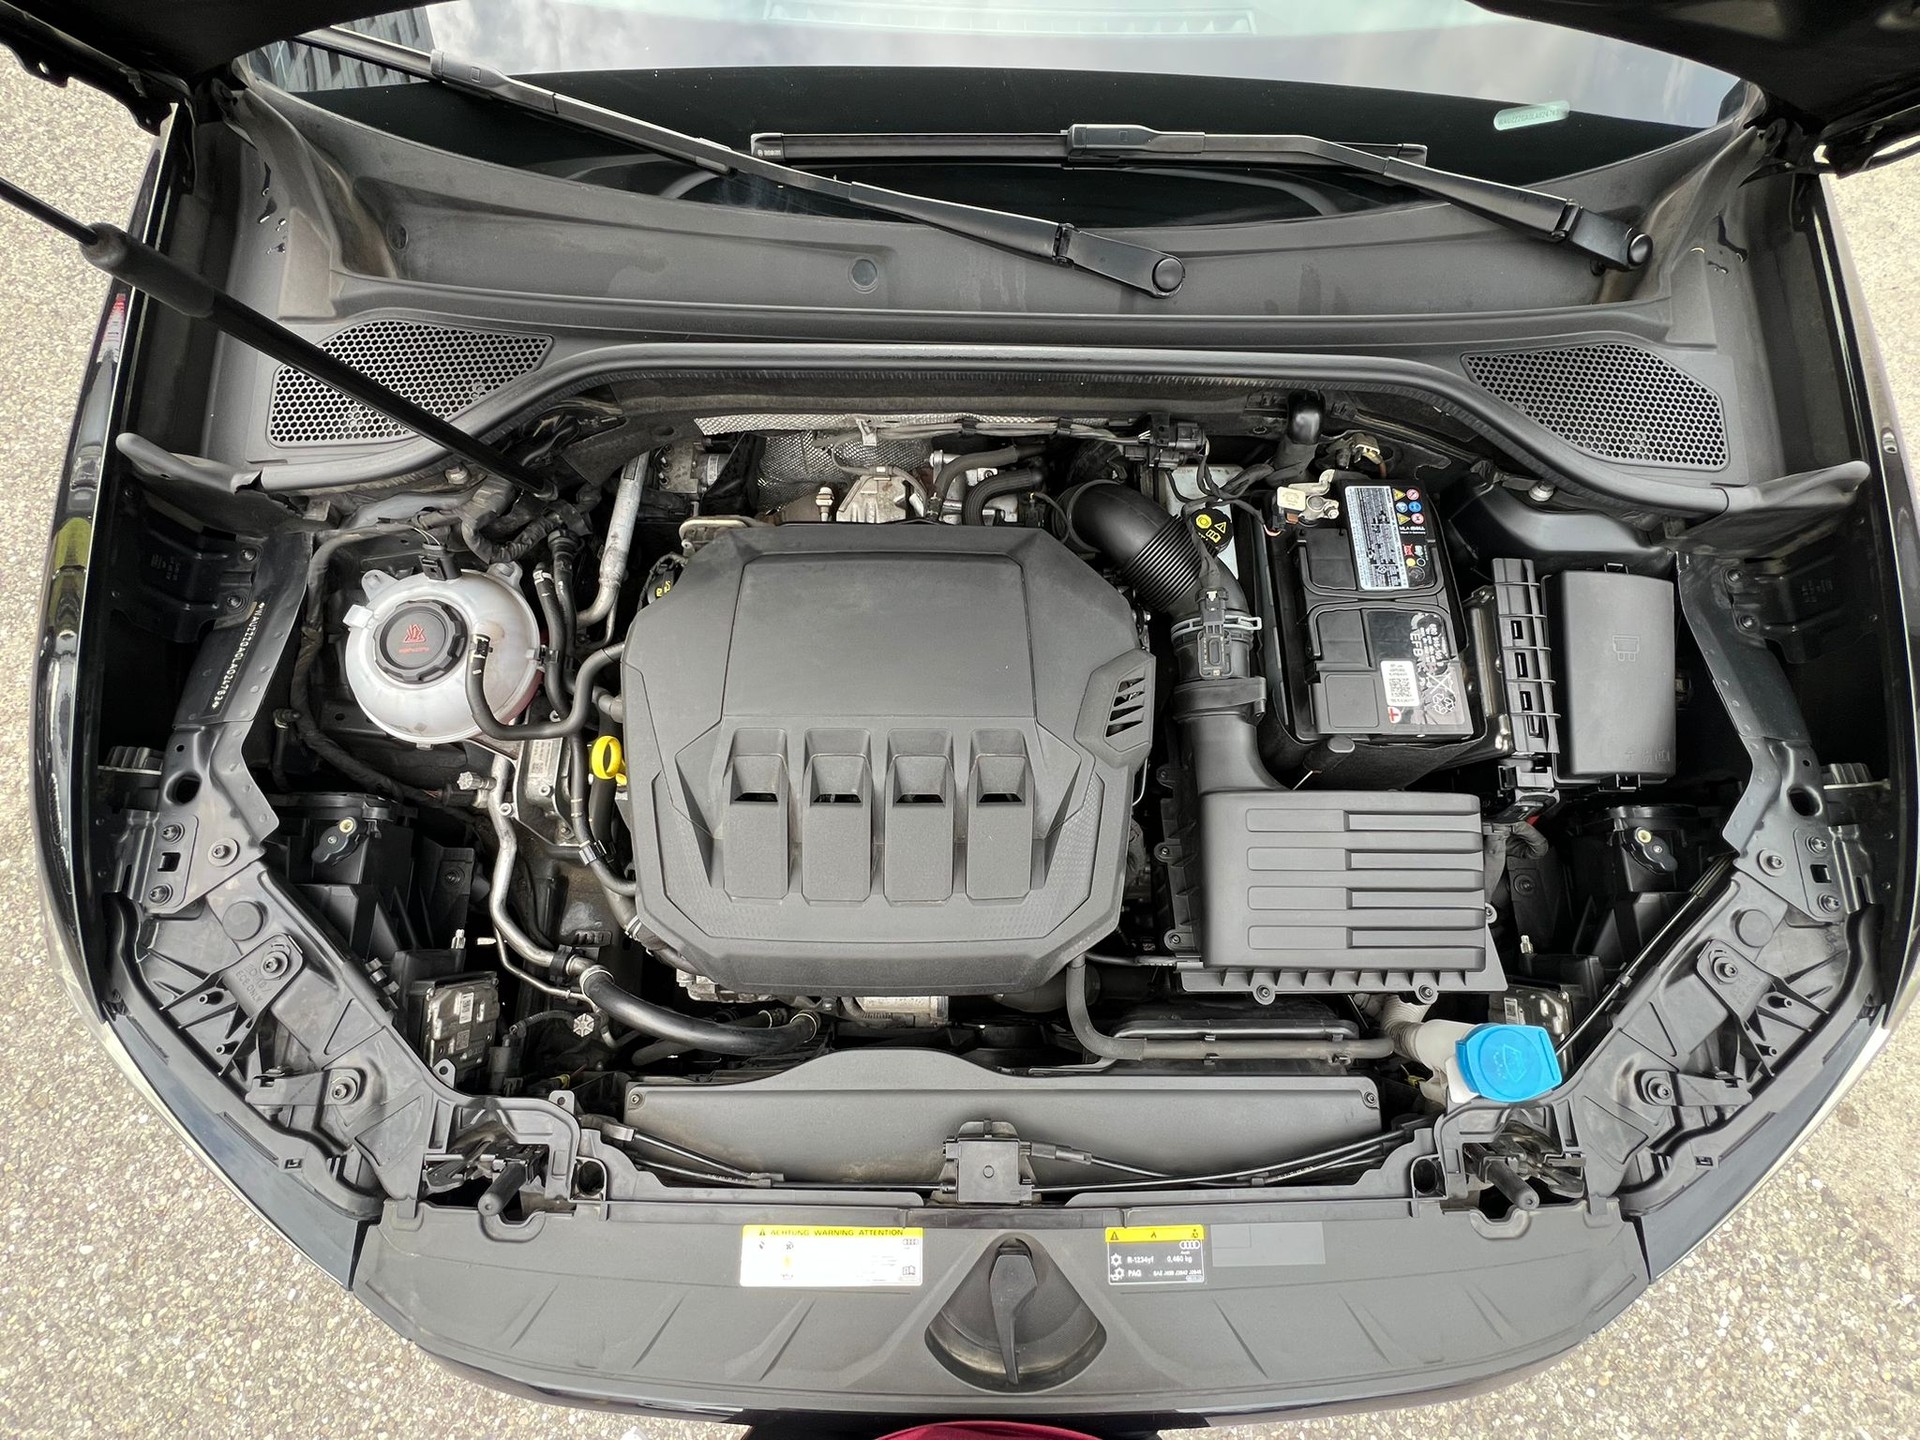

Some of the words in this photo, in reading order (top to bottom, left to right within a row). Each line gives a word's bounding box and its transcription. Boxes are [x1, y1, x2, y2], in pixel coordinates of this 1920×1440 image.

[1409, 632, 1424, 657] EFB
[236, 970, 250, 986] ECE
[246, 984, 263, 1001] ONLY
[1127, 1256, 1154, 1264] R-1234yf
